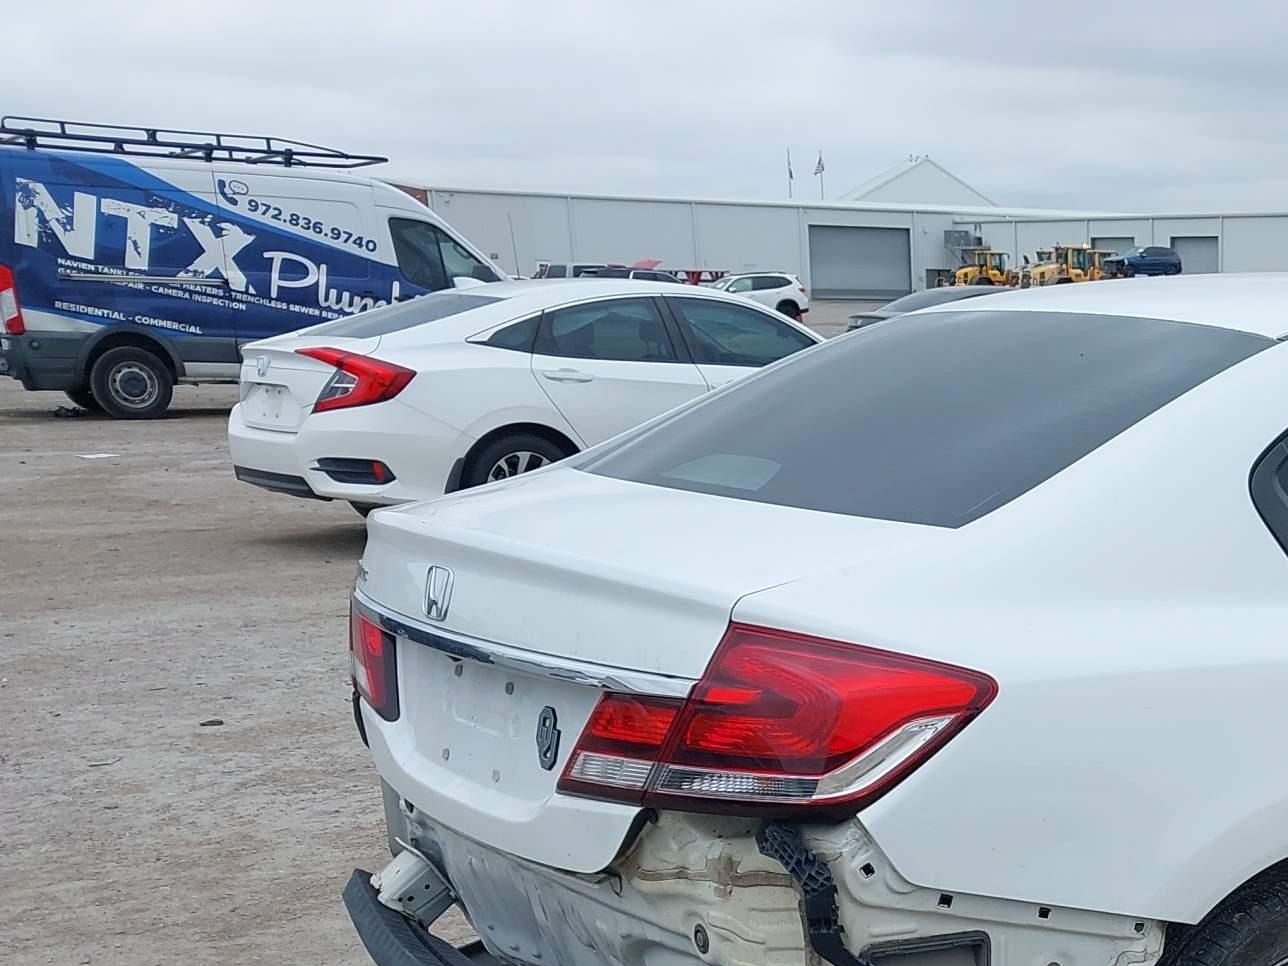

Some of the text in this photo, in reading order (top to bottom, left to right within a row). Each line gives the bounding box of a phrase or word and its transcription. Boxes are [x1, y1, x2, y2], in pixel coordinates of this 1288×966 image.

[14, 177, 256, 295] NTX
[247, 198, 377, 253] 972.836.9740
[57, 257, 95, 271] NAVIEN
[231, 291, 287, 310] TRENCHLESS
[289, 303, 321, 317] SEWER
[151, 285, 190, 299] CAMERA
[192, 293, 246, 310] INSPECTION
[54, 301, 126, 321] RESIDENTIAL
[134, 315, 203, 334] COMMERCIAL
